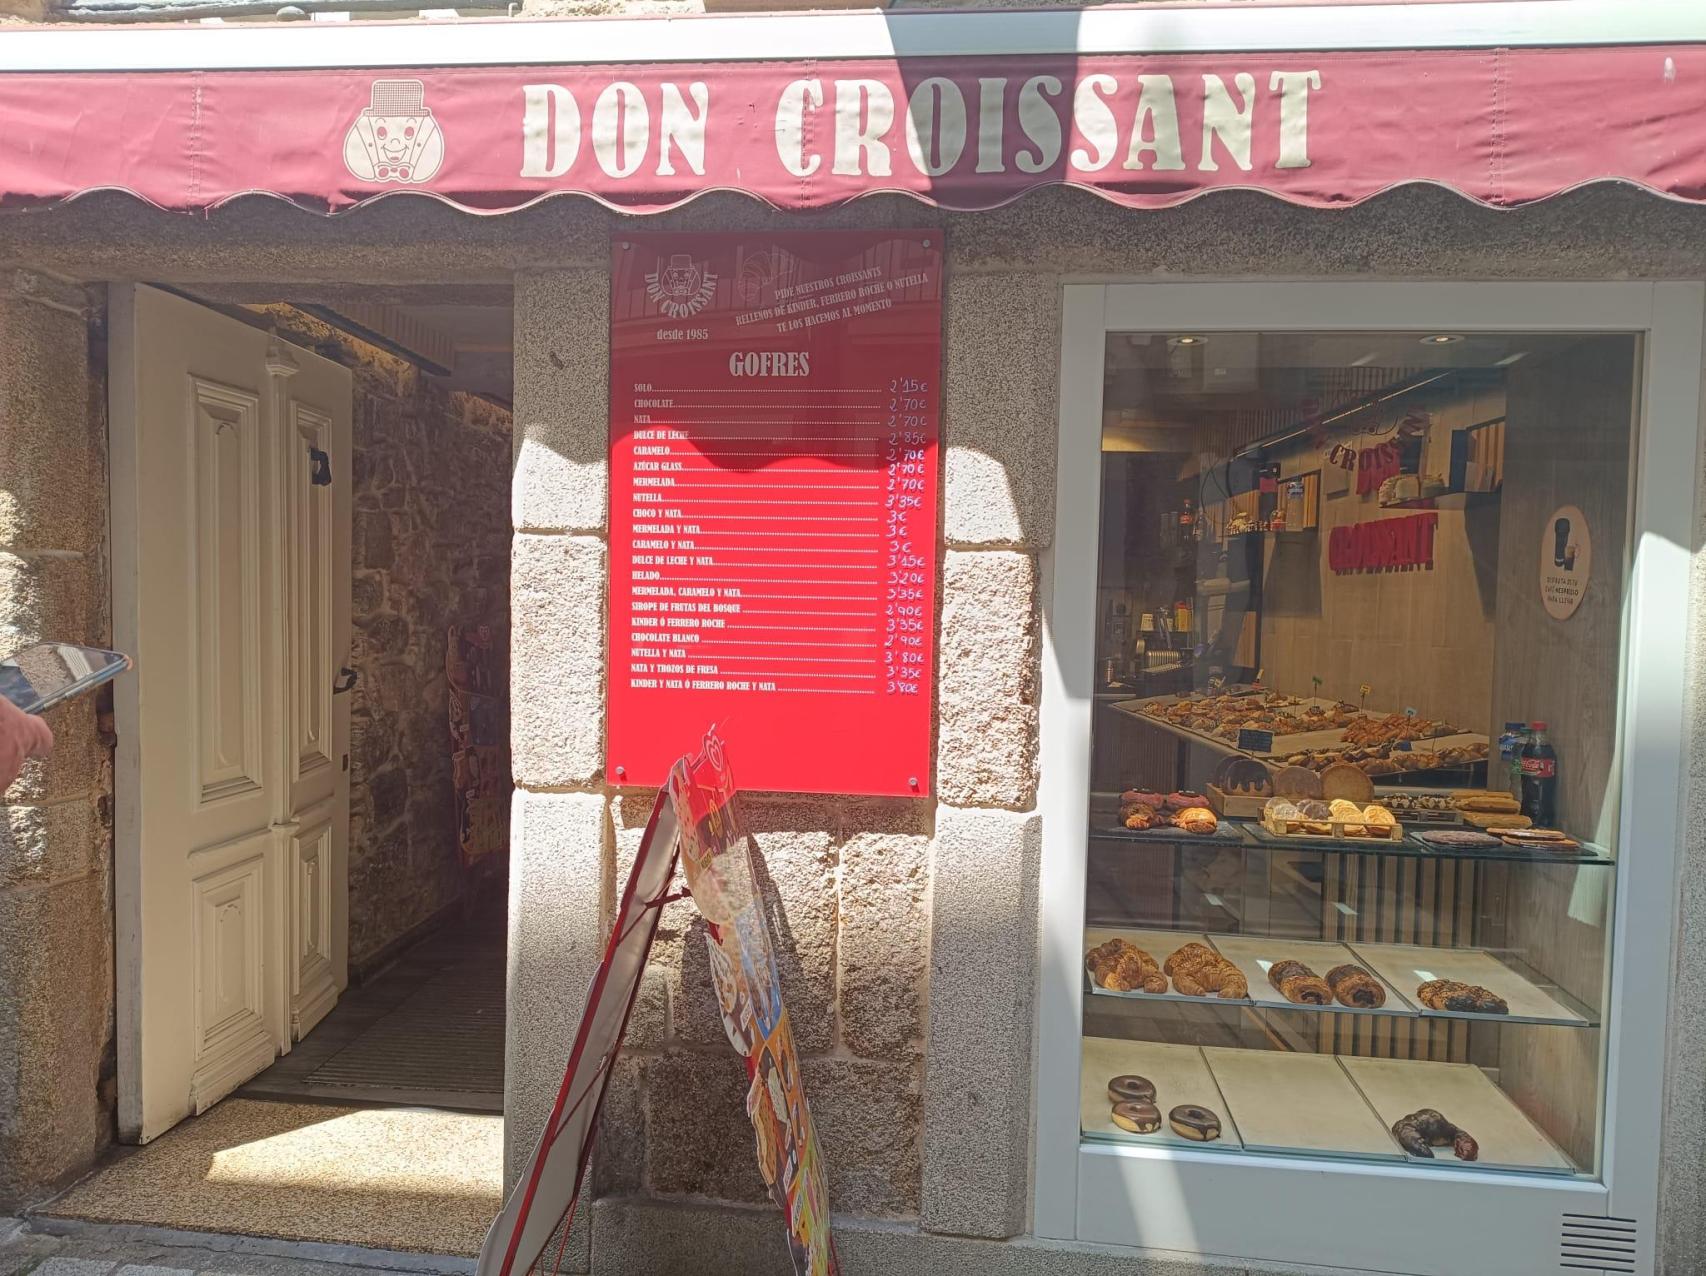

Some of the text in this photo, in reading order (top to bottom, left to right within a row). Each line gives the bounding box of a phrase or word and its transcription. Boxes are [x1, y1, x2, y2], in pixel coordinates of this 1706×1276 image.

[520, 69, 1323, 179] DON CROISSANT
[775, 265, 882, 300] PIDE NUESTROS CROISSANTS
[644, 272, 719, 319] DON CROISSANT
[735, 308, 773, 326] RELLENOS
[775, 304, 786, 317] DE
[820, 288, 857, 306] FERRERO
[858, 281, 886, 298] ROCHE
[887, 279, 894, 290] O
[894, 272, 929, 290] NUTELLA
[777, 298, 893, 333] TE LOS HACEMOS AL MOMENTO
[656, 327, 710, 341] desde 1985
[728, 351, 811, 377] GOFRES
[634, 383, 653, 393] SOLO
[634, 398, 674, 408] CHOCOLATE
[633, 414, 652, 424] NATA
[633, 430, 688, 441] DULCE DE LECHE
[633, 445, 671, 455] CARAMELO
[633, 460, 682, 471] AZÚCAR GLASS
[633, 477, 676, 487] MERMELADA
[632, 492, 663, 502] NUTELLA
[632, 508, 682, 518] CHOCO Y NATA
[632, 523, 701, 535] MERMELADA Y NATA
[632, 539, 695, 550] CARAMELO Y NATA
[632, 555, 714, 566] DULCE DE LECHE Y NATA
[632, 570, 661, 580] HELADO
[632, 586, 741, 598] MERMELADA, CARAMELO Y NATA
[631, 601, 741, 614] SIROPE DE FRUTAS DEL BOSQUE
[631, 616, 725, 628] KINDER Ó FERRERO ROCHE
[631, 632, 700, 643] CHOCOLATE BLANCO
[631, 647, 687, 658] NUTELLA Y NATA
[630, 663, 719, 675] NATA Y TROZOS DE FRESA
[630, 679, 777, 692] KINDER Y NATA Ó FERRERO ROCHE Y NATA
